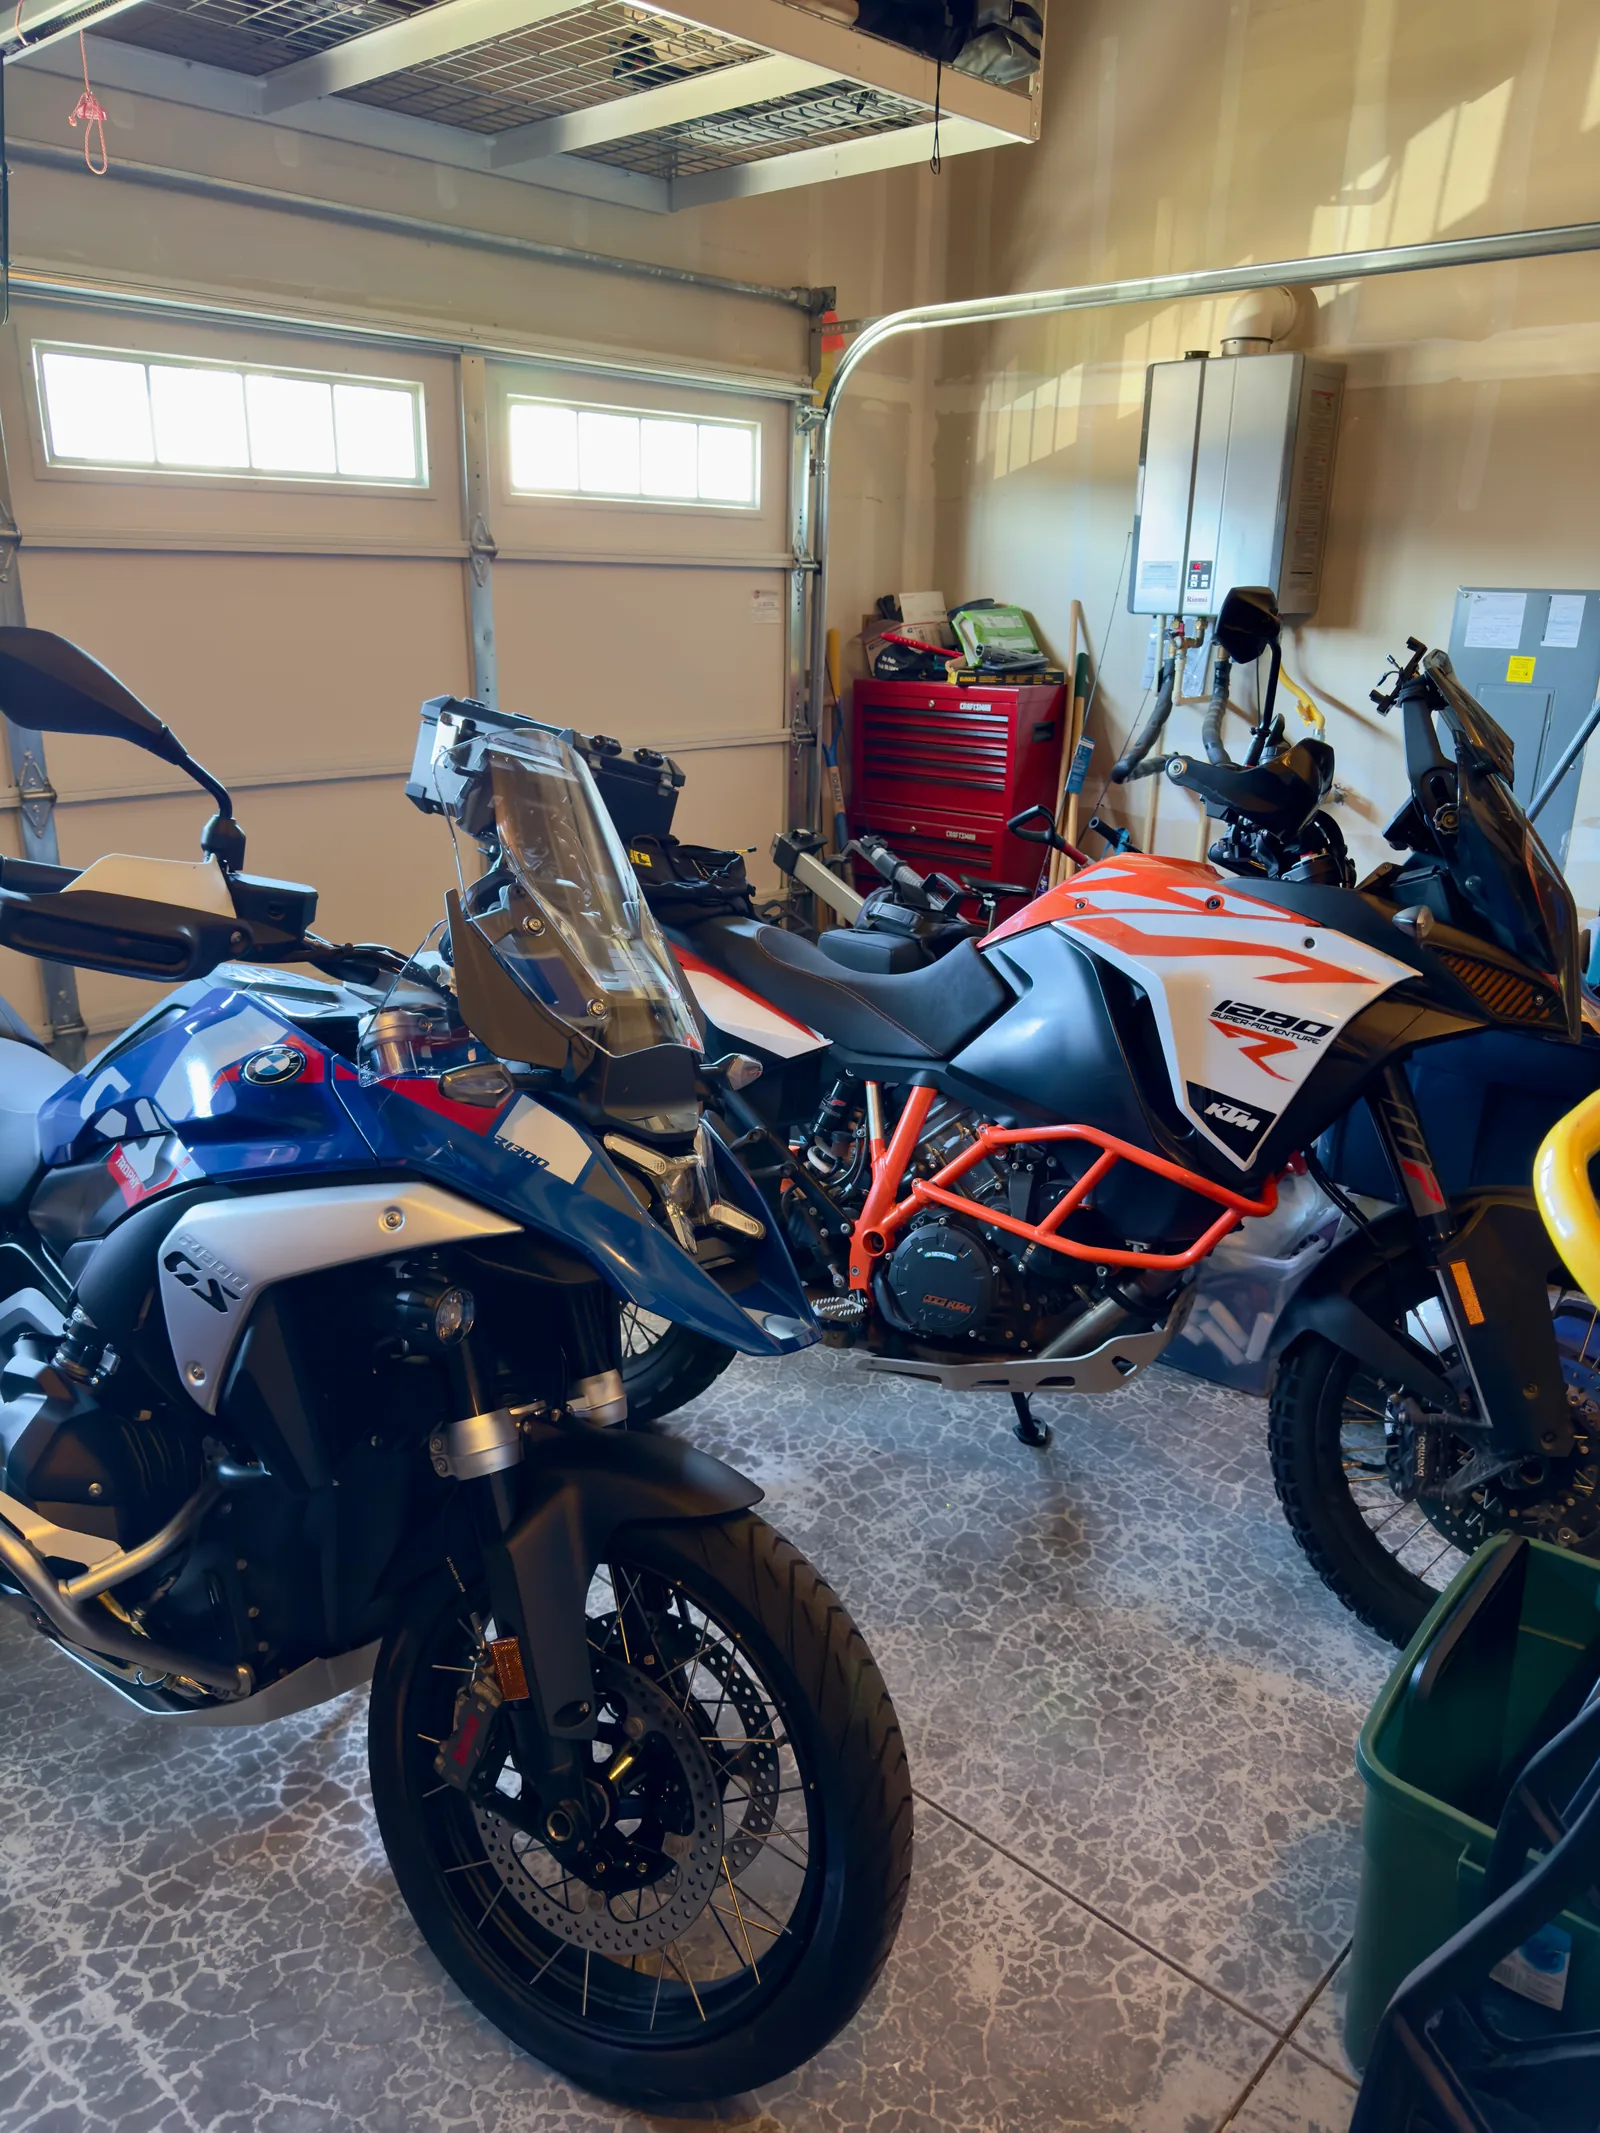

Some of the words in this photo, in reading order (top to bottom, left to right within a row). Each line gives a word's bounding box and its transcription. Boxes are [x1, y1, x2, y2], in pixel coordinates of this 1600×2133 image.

[960, 702, 991, 712] CRAFTSMAN
[946, 830, 976, 841] CRAFTSMAN
[1214, 1000, 1335, 1037] 1290
[1204, 1102, 1261, 1132] KTM
[115, 1155, 141, 1189] TROPHY
[163, 1250, 242, 1315] GS
[1414, 1435, 1426, 1477] brembo
